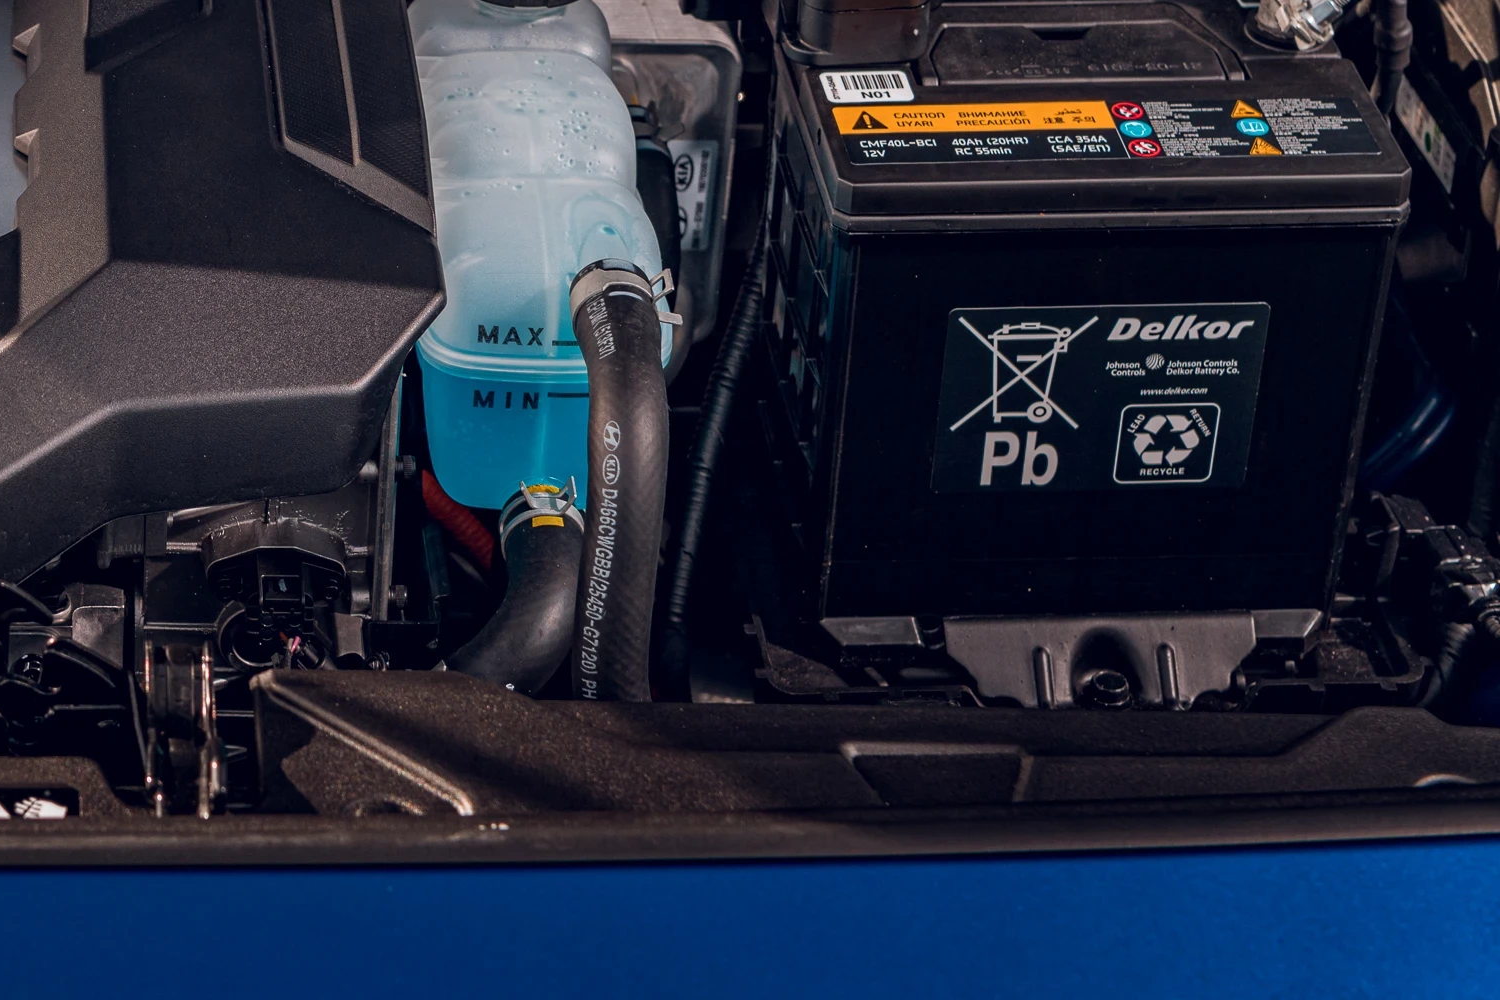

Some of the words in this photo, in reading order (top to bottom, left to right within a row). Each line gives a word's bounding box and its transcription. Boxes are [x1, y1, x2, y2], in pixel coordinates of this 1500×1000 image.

[893, 111, 945, 119] CAUTION
[958, 110, 1027, 118] ВНИМАНИЕ
[956, 117, 1031, 126] PRECAUCIÓN
[859, 138, 937, 148] CMF40L-BCI
[951, 137, 983, 146] 40Ah
[987, 136, 1029, 146] (20HR)
[1047, 135, 1073, 144] CCA
[1076, 134, 1107, 143] 354A
[863, 149, 886, 158] 12V
[955, 147, 973, 155] RC
[975, 146, 1013, 155] 55min
[1051, 144, 1111, 153] (SAE/EN)
[1107, 314, 1255, 341] Delkor
[476, 323, 545, 347] MAX
[1105, 361, 1141, 370] Johnson
[1167, 360, 1202, 368] Johnson
[1203, 358, 1238, 367] Controls
[1111, 368, 1146, 377] Controls
[1166, 367, 1194, 376] Delkor
[1195, 367, 1225, 376] Battery
[1226, 366, 1240, 374] Co.
[1140, 386, 1208, 396] www.delkor.com
[472, 389, 540, 410] MIN
[1126, 413, 1146, 434] LEAD
[1189, 408, 1212, 438] RETURN
[979, 430, 1059, 486] Pb
[1139, 467, 1185, 476] RECYCLE
